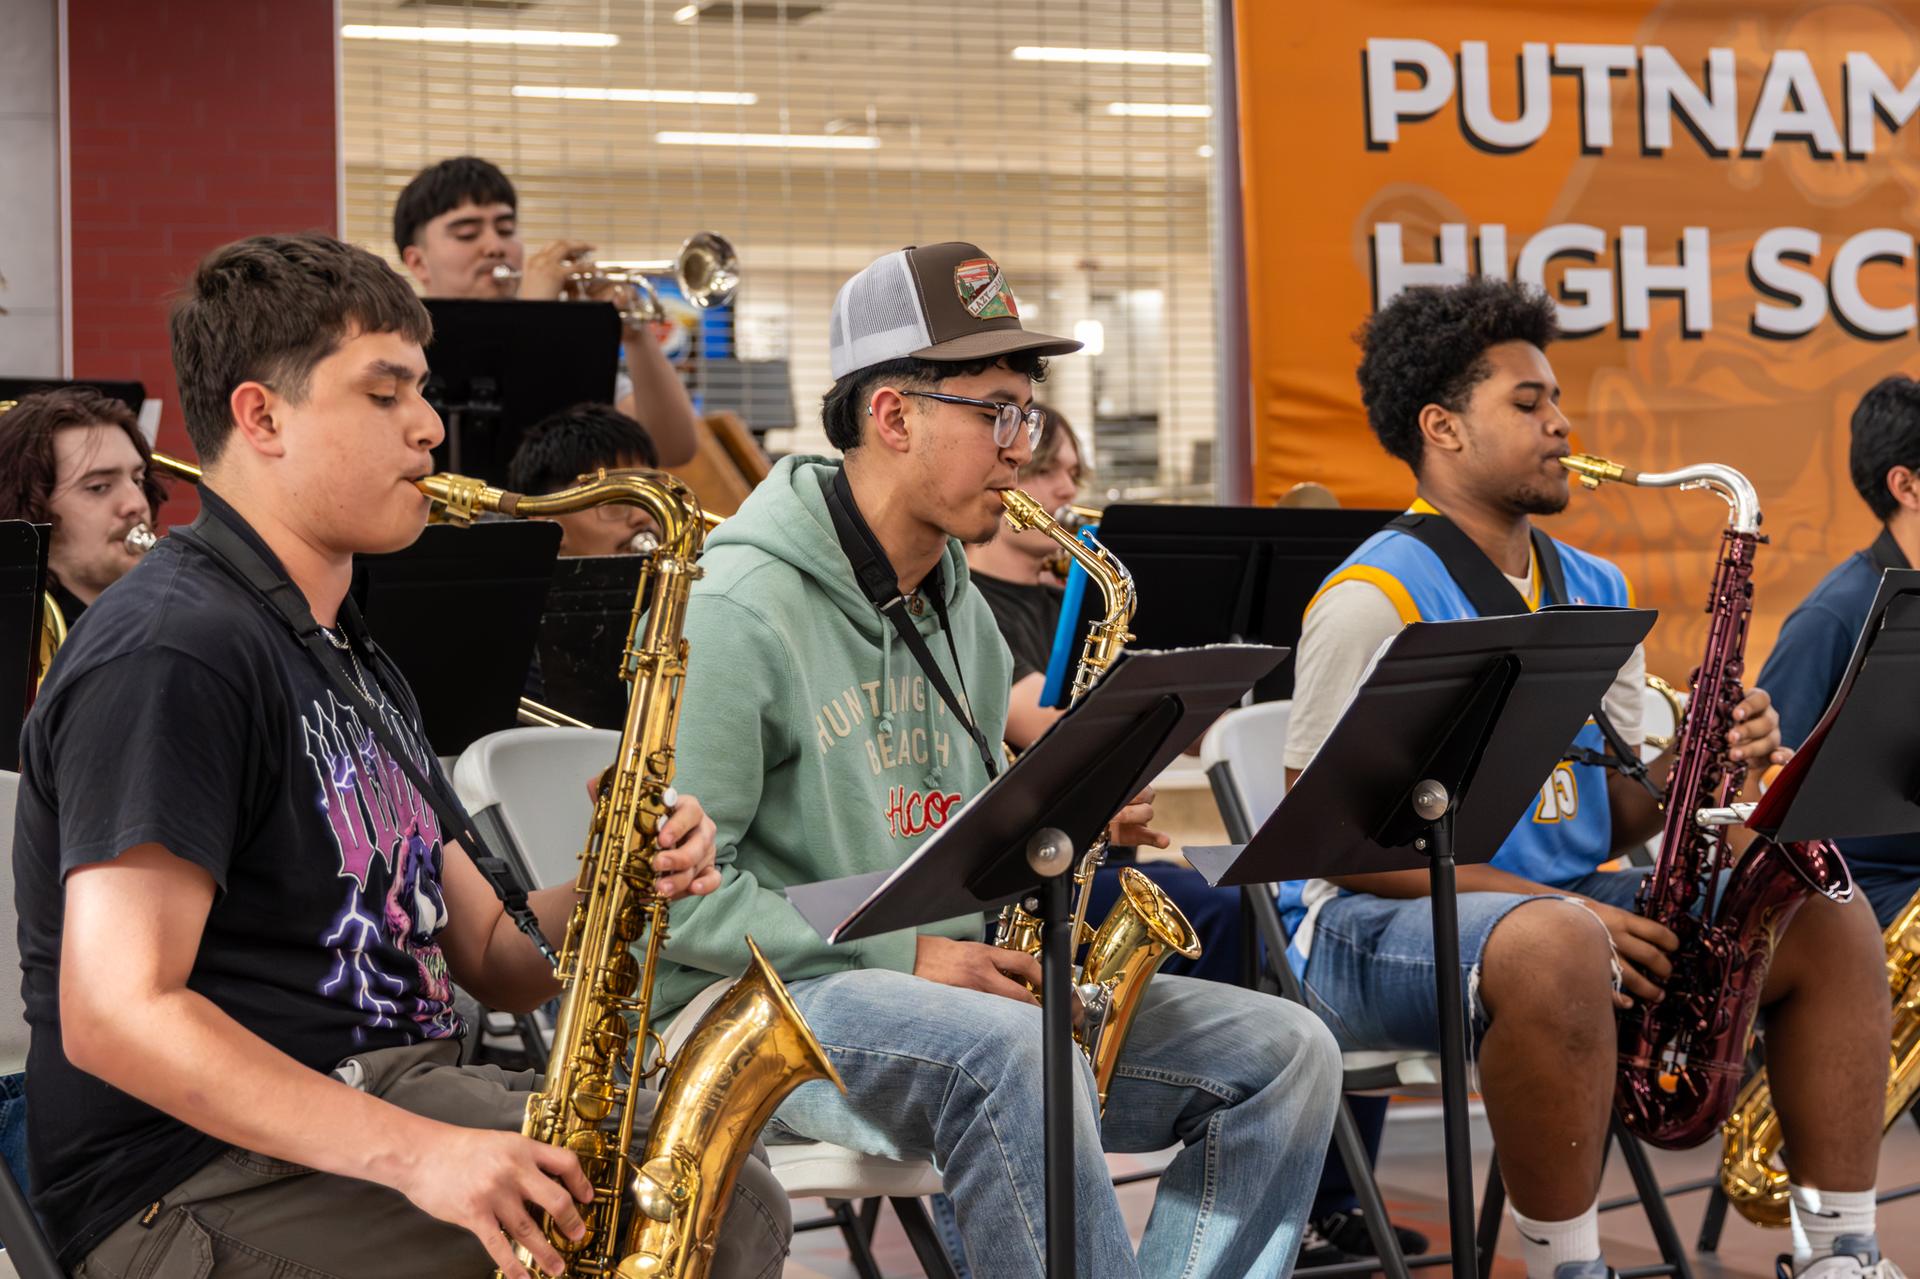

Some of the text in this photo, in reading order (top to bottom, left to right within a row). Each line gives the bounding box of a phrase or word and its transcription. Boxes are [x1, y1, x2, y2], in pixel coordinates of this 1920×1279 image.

[1362, 37, 1920, 161] PUTNAM
[970, 291, 991, 314] LAZY
[815, 675, 977, 754] HUNTING
[865, 728, 949, 775] BEACH
